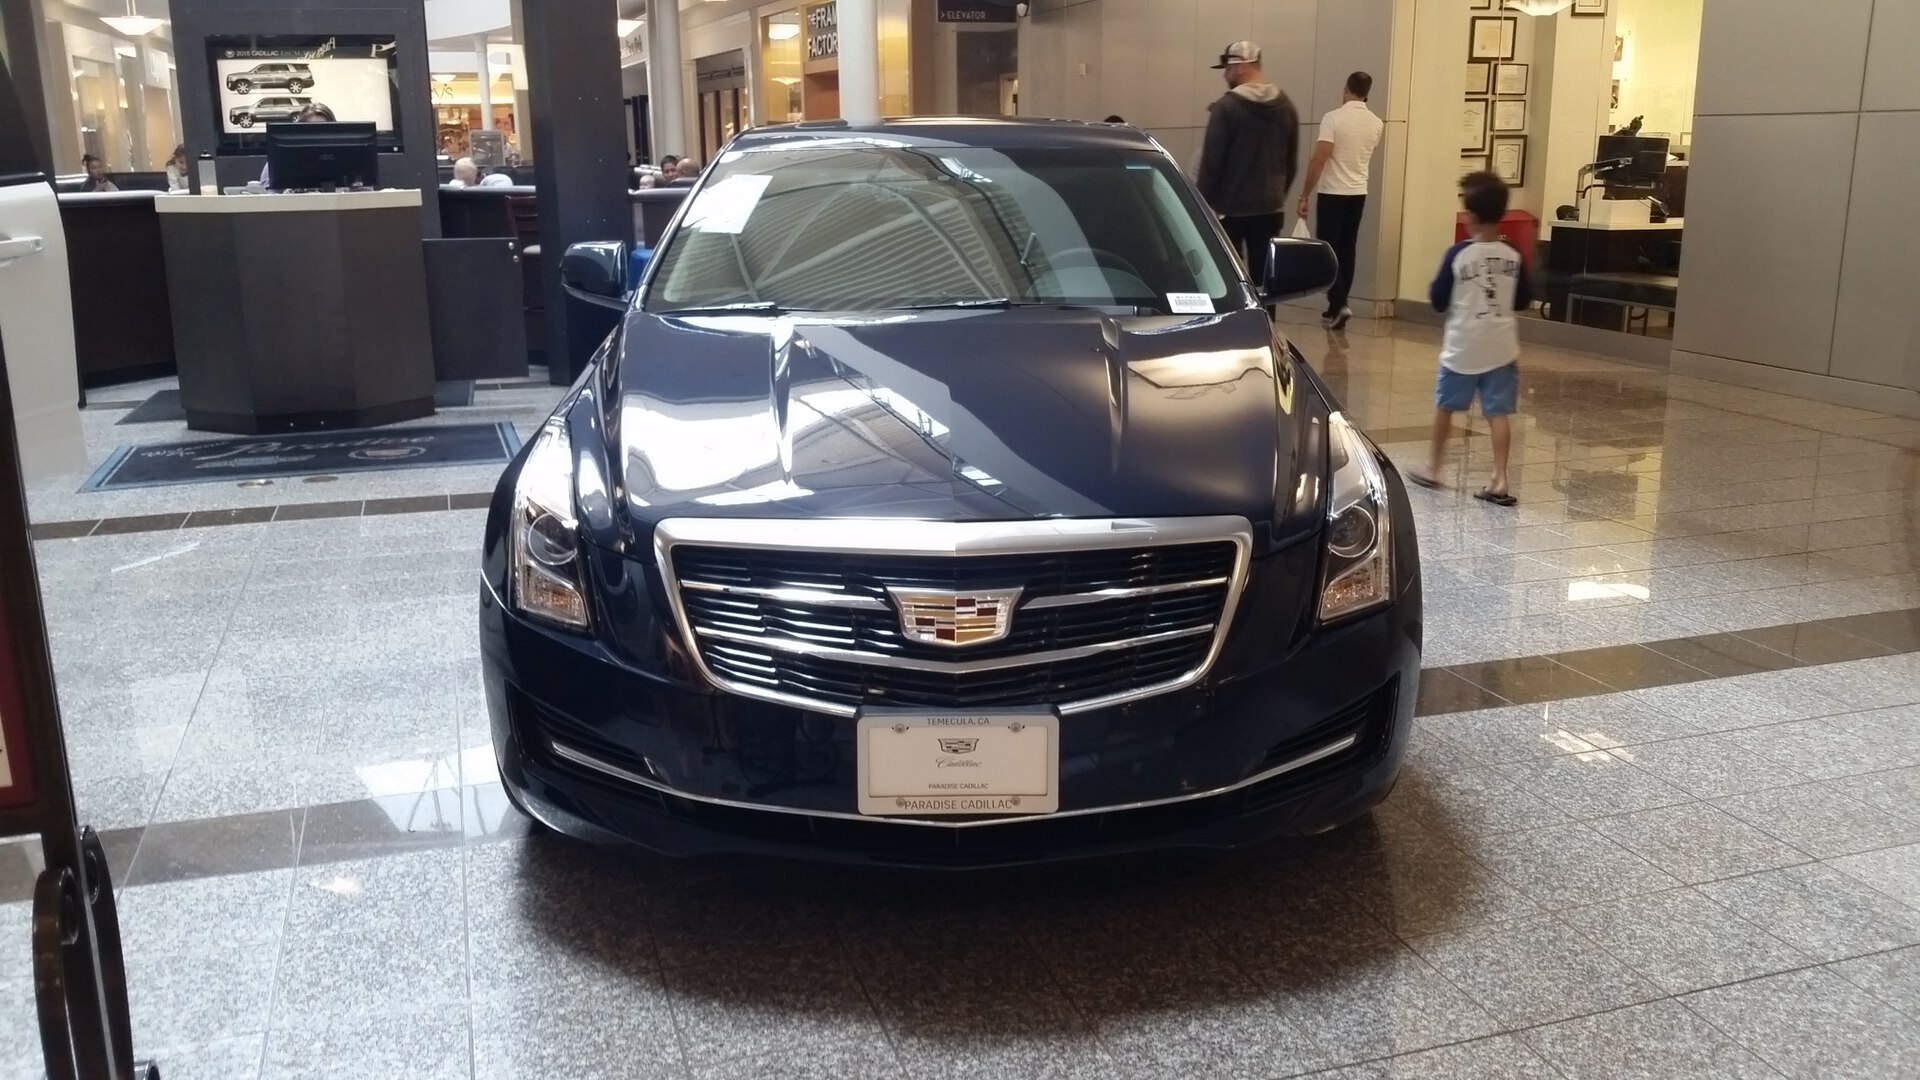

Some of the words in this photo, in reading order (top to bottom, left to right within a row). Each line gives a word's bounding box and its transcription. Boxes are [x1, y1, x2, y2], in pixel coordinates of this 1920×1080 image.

[947, 10, 986, 20] ELEVATOR
[807, 32, 838, 58] FACTOR
[977, 717, 990, 726] CA
[935, 756, 983, 769] Cadillac
[904, 799, 958, 811] PARADISE
[960, 799, 1013, 810] CADILLAC
